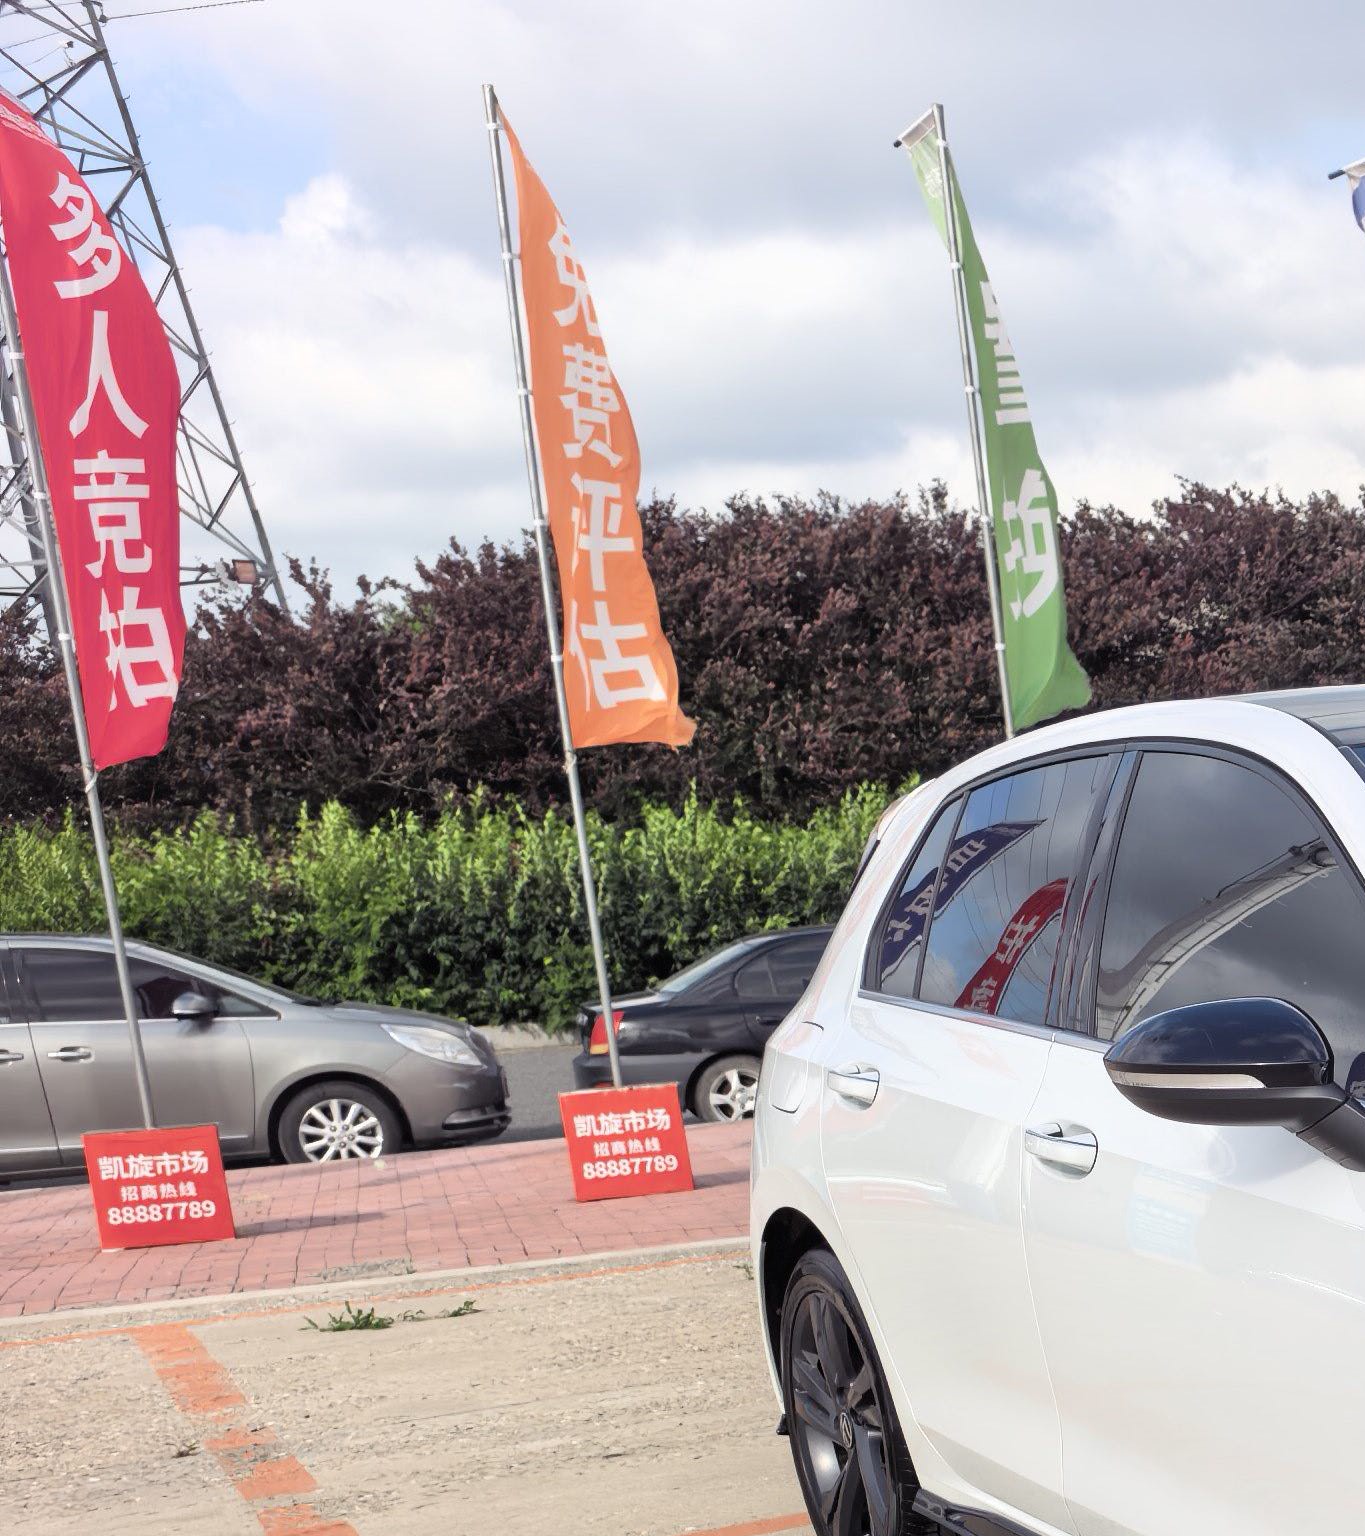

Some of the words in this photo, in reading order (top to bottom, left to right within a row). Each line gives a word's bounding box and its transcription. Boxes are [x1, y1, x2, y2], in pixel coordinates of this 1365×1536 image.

[49, 171, 178, 711] 多人竞拍
[573, 1108, 671, 1138] 凯旋市场
[97, 1150, 209, 1180] 凯旋市场
[582, 1154, 678, 1179] 88887789
[120, 1181, 197, 1202] 招商热线
[107, 1199, 216, 1225] 88887789
